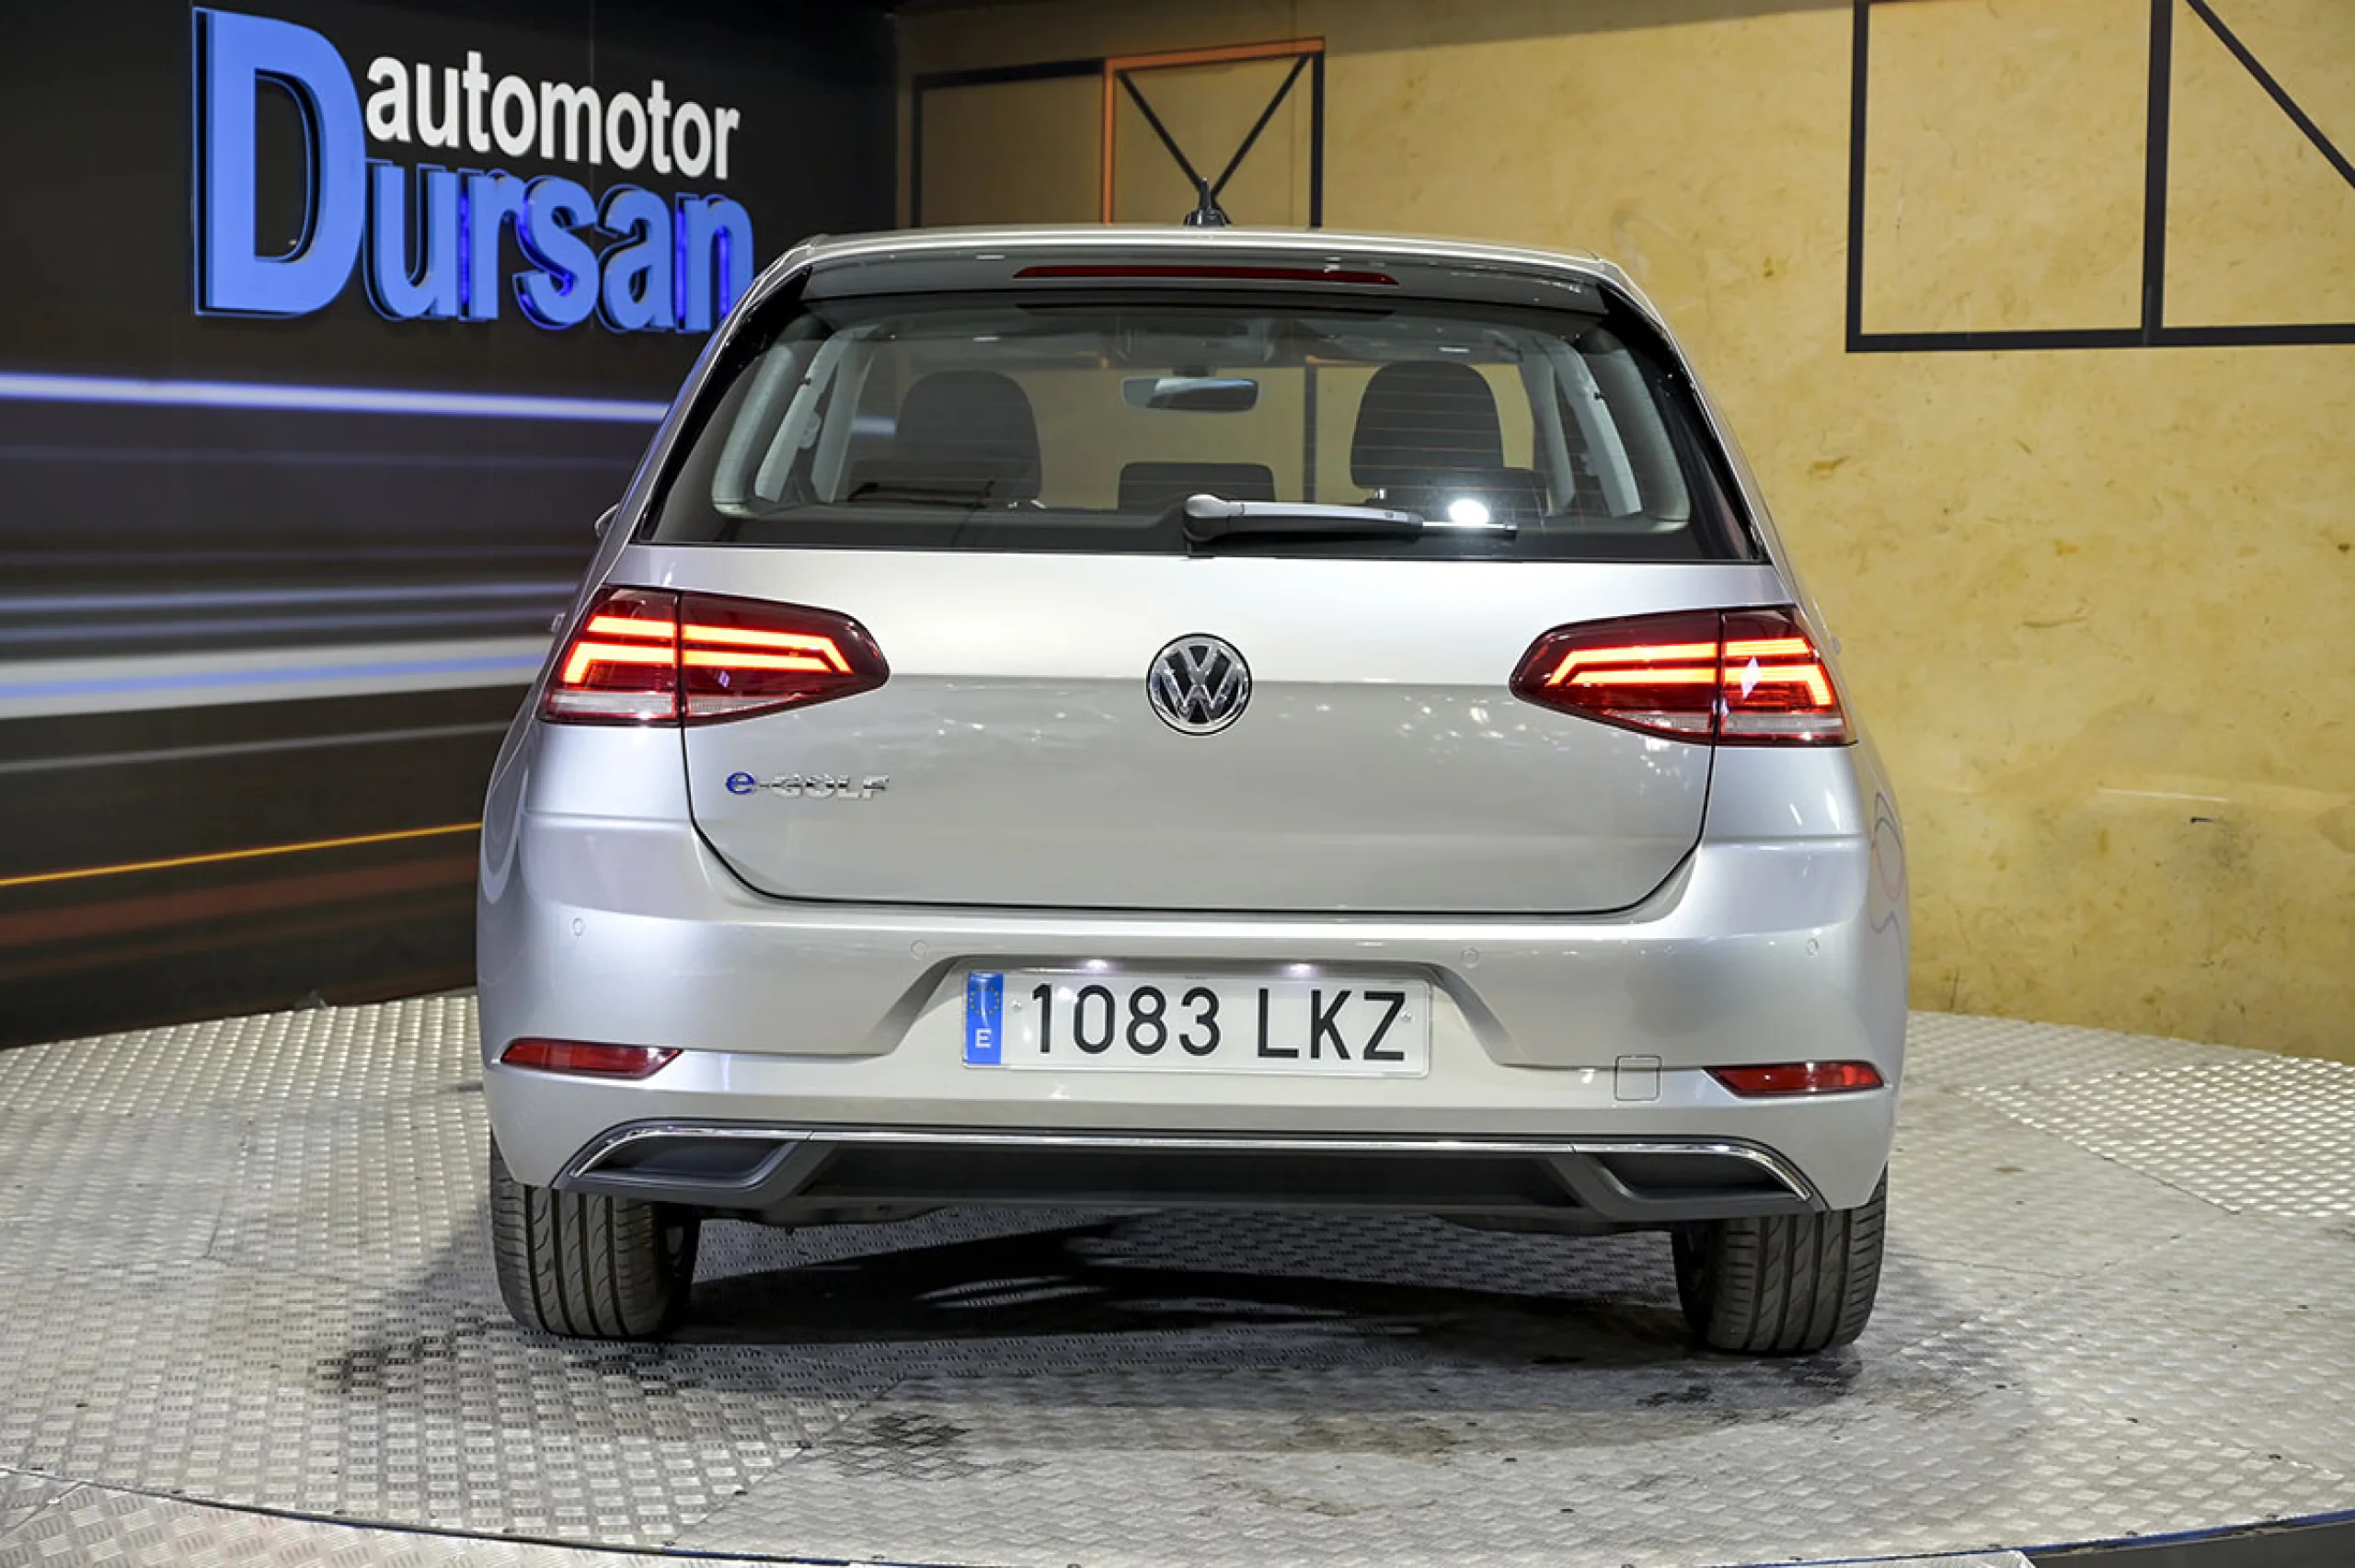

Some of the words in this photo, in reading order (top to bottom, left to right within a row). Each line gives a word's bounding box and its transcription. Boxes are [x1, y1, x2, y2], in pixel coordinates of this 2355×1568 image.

[193, 6, 754, 334] Dursan
[366, 51, 741, 180] automotor
[974, 1028, 992, 1048] E
[1031, 982, 1222, 1057] 1083
[1257, 988, 1407, 1061] LKZ
